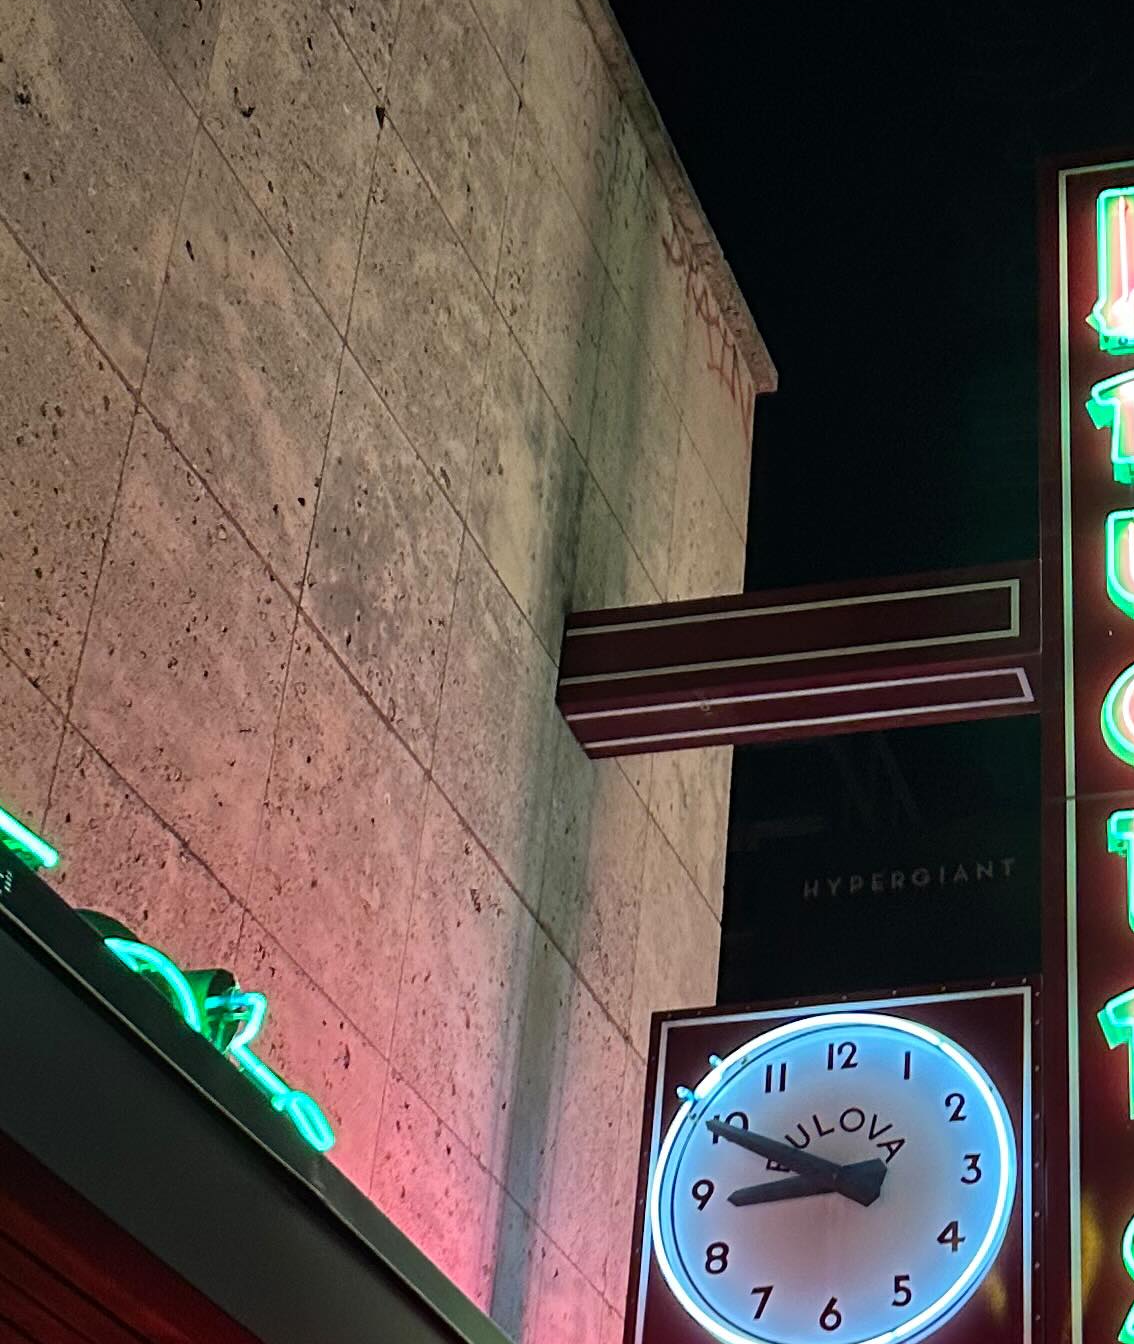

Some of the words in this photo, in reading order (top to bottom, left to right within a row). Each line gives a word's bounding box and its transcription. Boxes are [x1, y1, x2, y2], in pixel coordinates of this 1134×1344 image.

[827, 1041, 858, 1070] 12
[904, 1051, 911, 1080] 1
[764, 1064, 786, 1093] 11
[945, 1093, 967, 1121] 2
[961, 1154, 982, 1184] 3
[691, 1180, 714, 1210] 9
[937, 1221, 966, 1252] 4
[705, 1242, 729, 1274] 8
[751, 1286, 773, 1320] 7
[892, 1274, 912, 1307] 5
[819, 1297, 843, 1332] 6
